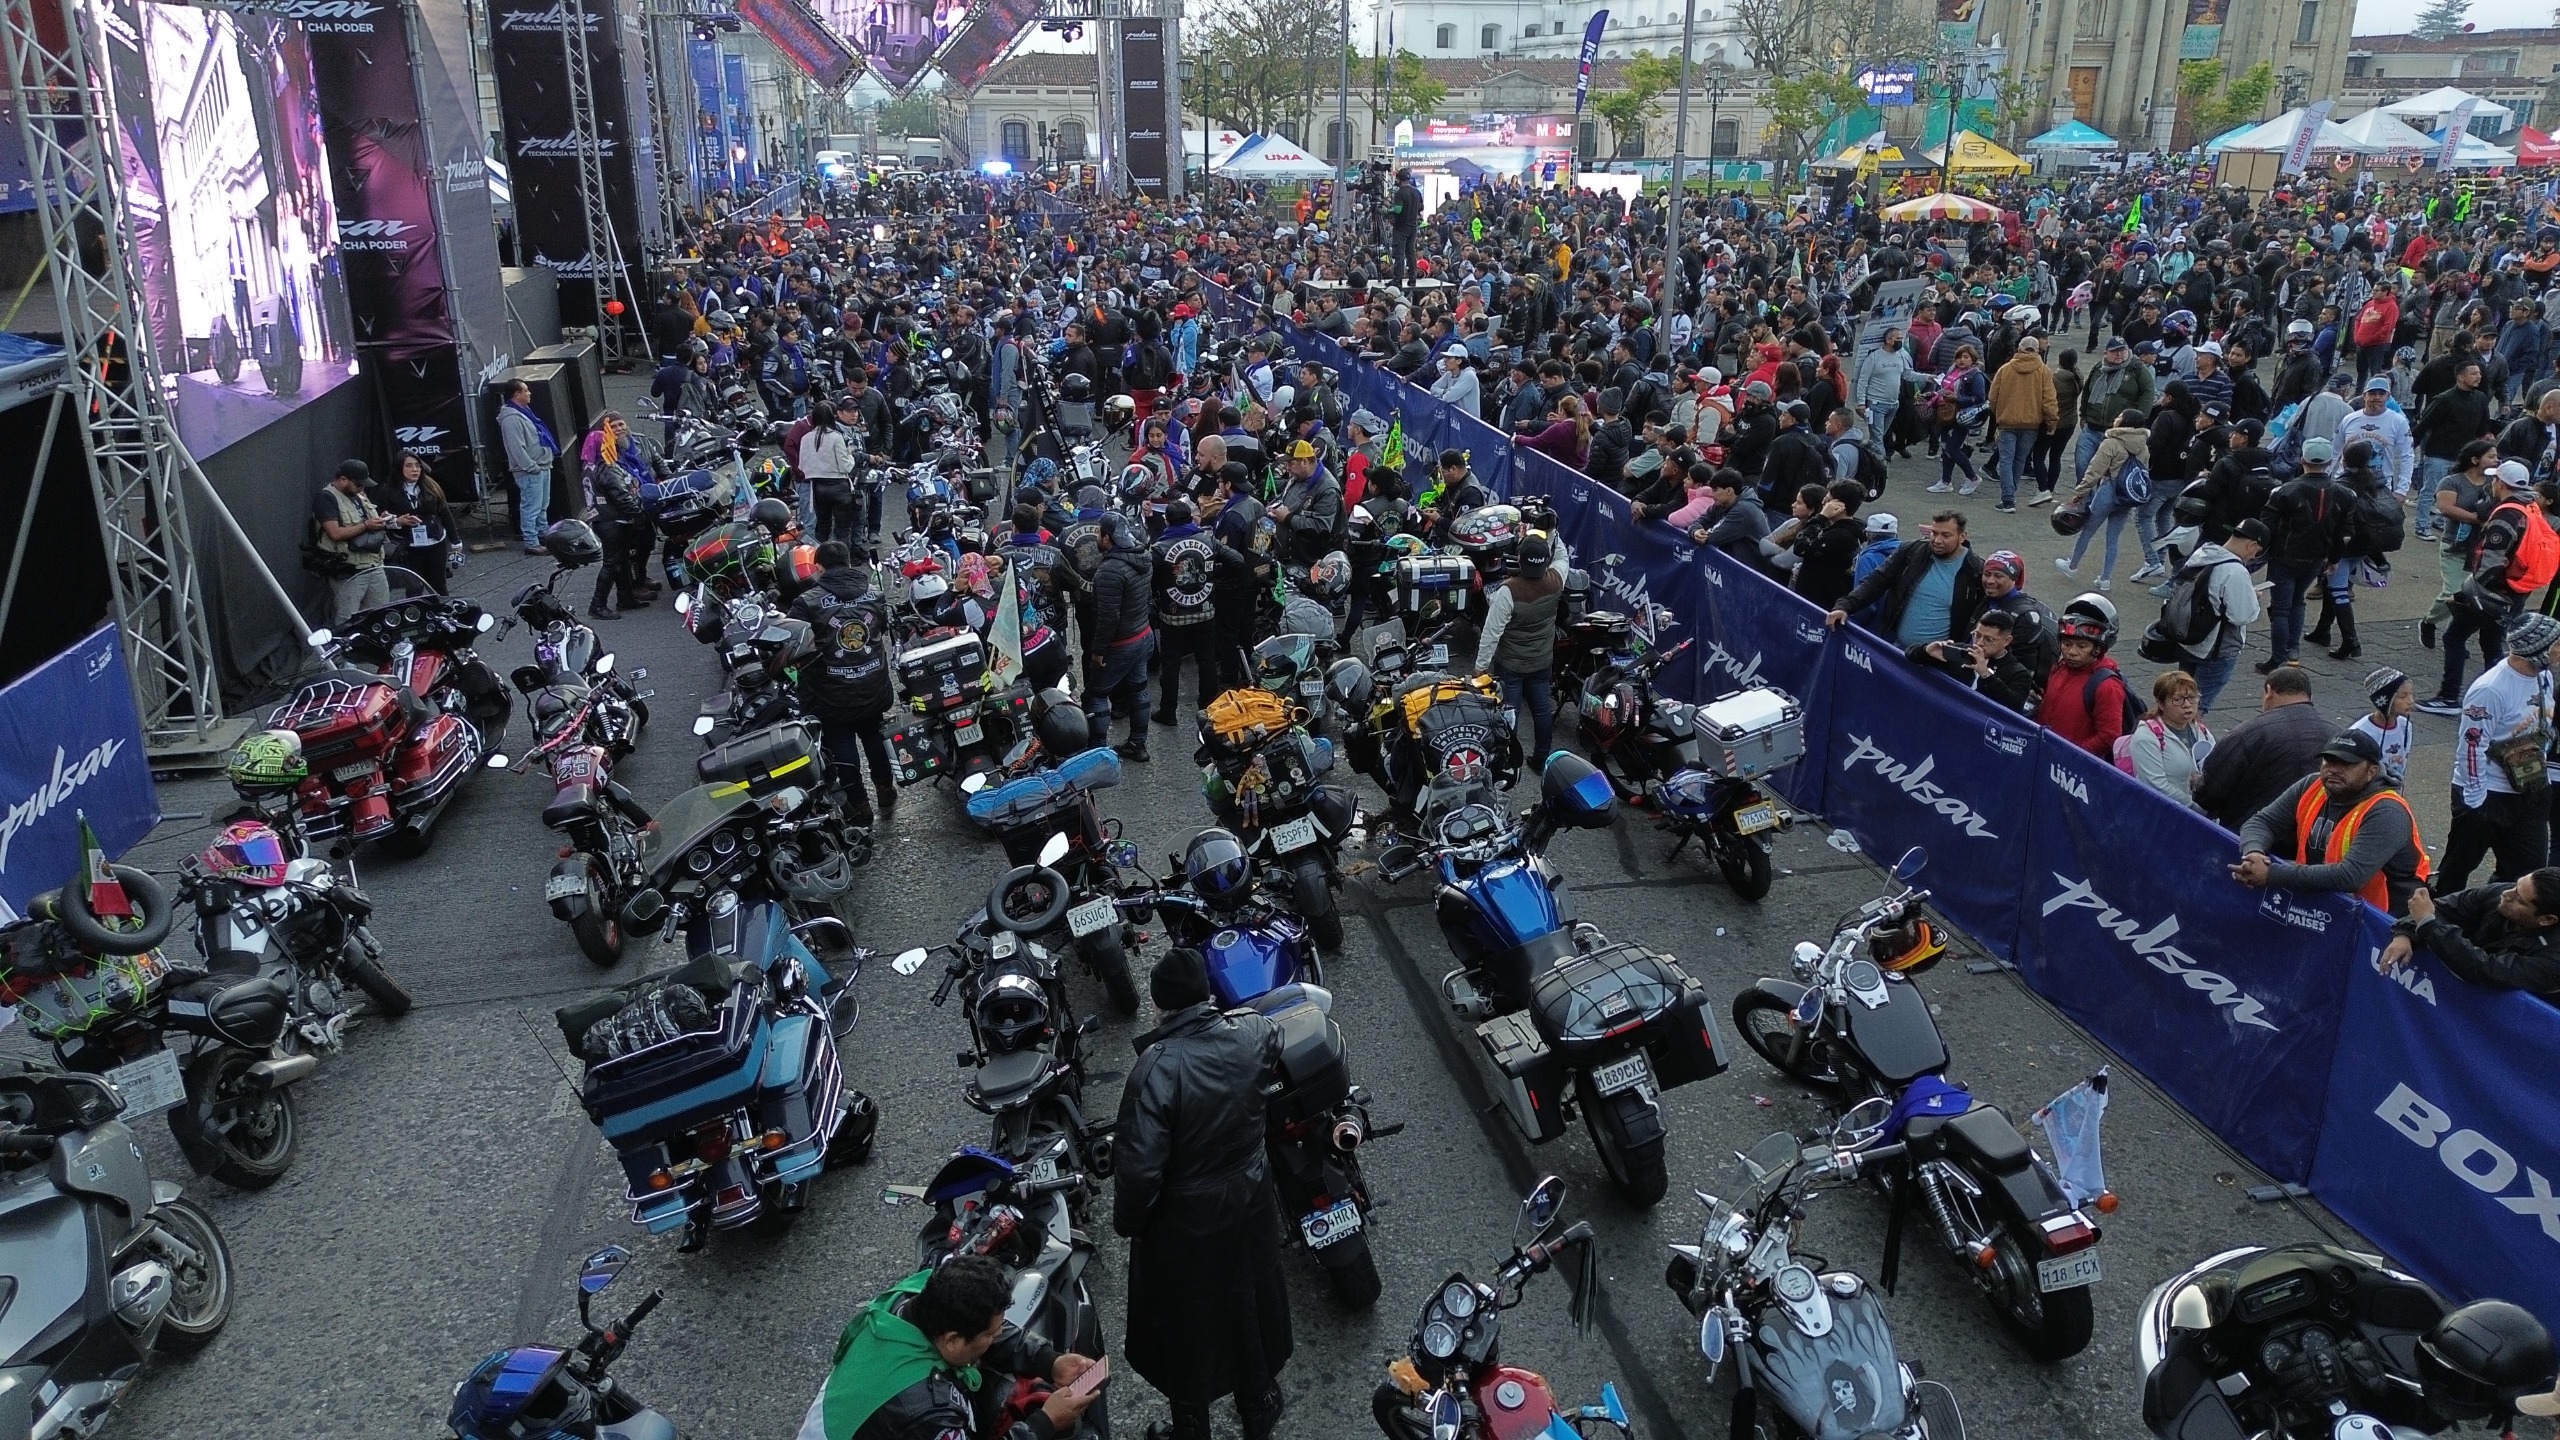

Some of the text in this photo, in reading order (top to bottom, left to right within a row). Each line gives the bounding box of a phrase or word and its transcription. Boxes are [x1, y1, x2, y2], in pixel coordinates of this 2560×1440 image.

[335, 23, 374, 33] PODER
[1578, 41, 1597, 90] Mobil
[1537, 124, 1571, 136] Mobil
[2291, 127, 2311, 166] ZORROS
[444, 146, 486, 193] pulsar
[370, 240, 408, 250] PODER
[478, 344, 510, 397] pulsar
[1067, 530, 1084, 546] IRON
[1167, 541, 1212, 562] IRON LEGACY
[1705, 566, 1723, 588] UMA
[1169, 584, 1212, 604] GUATEMALA
[1845, 644, 1873, 673] UMA
[1435, 726, 1484, 745] UMBRELLA
[2001, 741, 2023, 755] PAÍSES
[557, 761, 591, 784] 23
[2050, 763, 2089, 805] UMA
[1843, 732, 1999, 839] pulsar
[1074, 905, 1110, 929] 66SUG7
[2262, 901, 2286, 919] BAJAJ
[2287, 913, 2326, 932] PAÍSES
[2042, 871, 2280, 1032] pulsar
[1595, 1060, 1647, 1090] M889CXC
[1303, 1206, 1358, 1238] M4HRX
[1315, 1225, 1360, 1249] SUZUKI
[2042, 1260, 2099, 1285] M18FCX
[1026, 1282, 1044, 1311] CFMOTO
